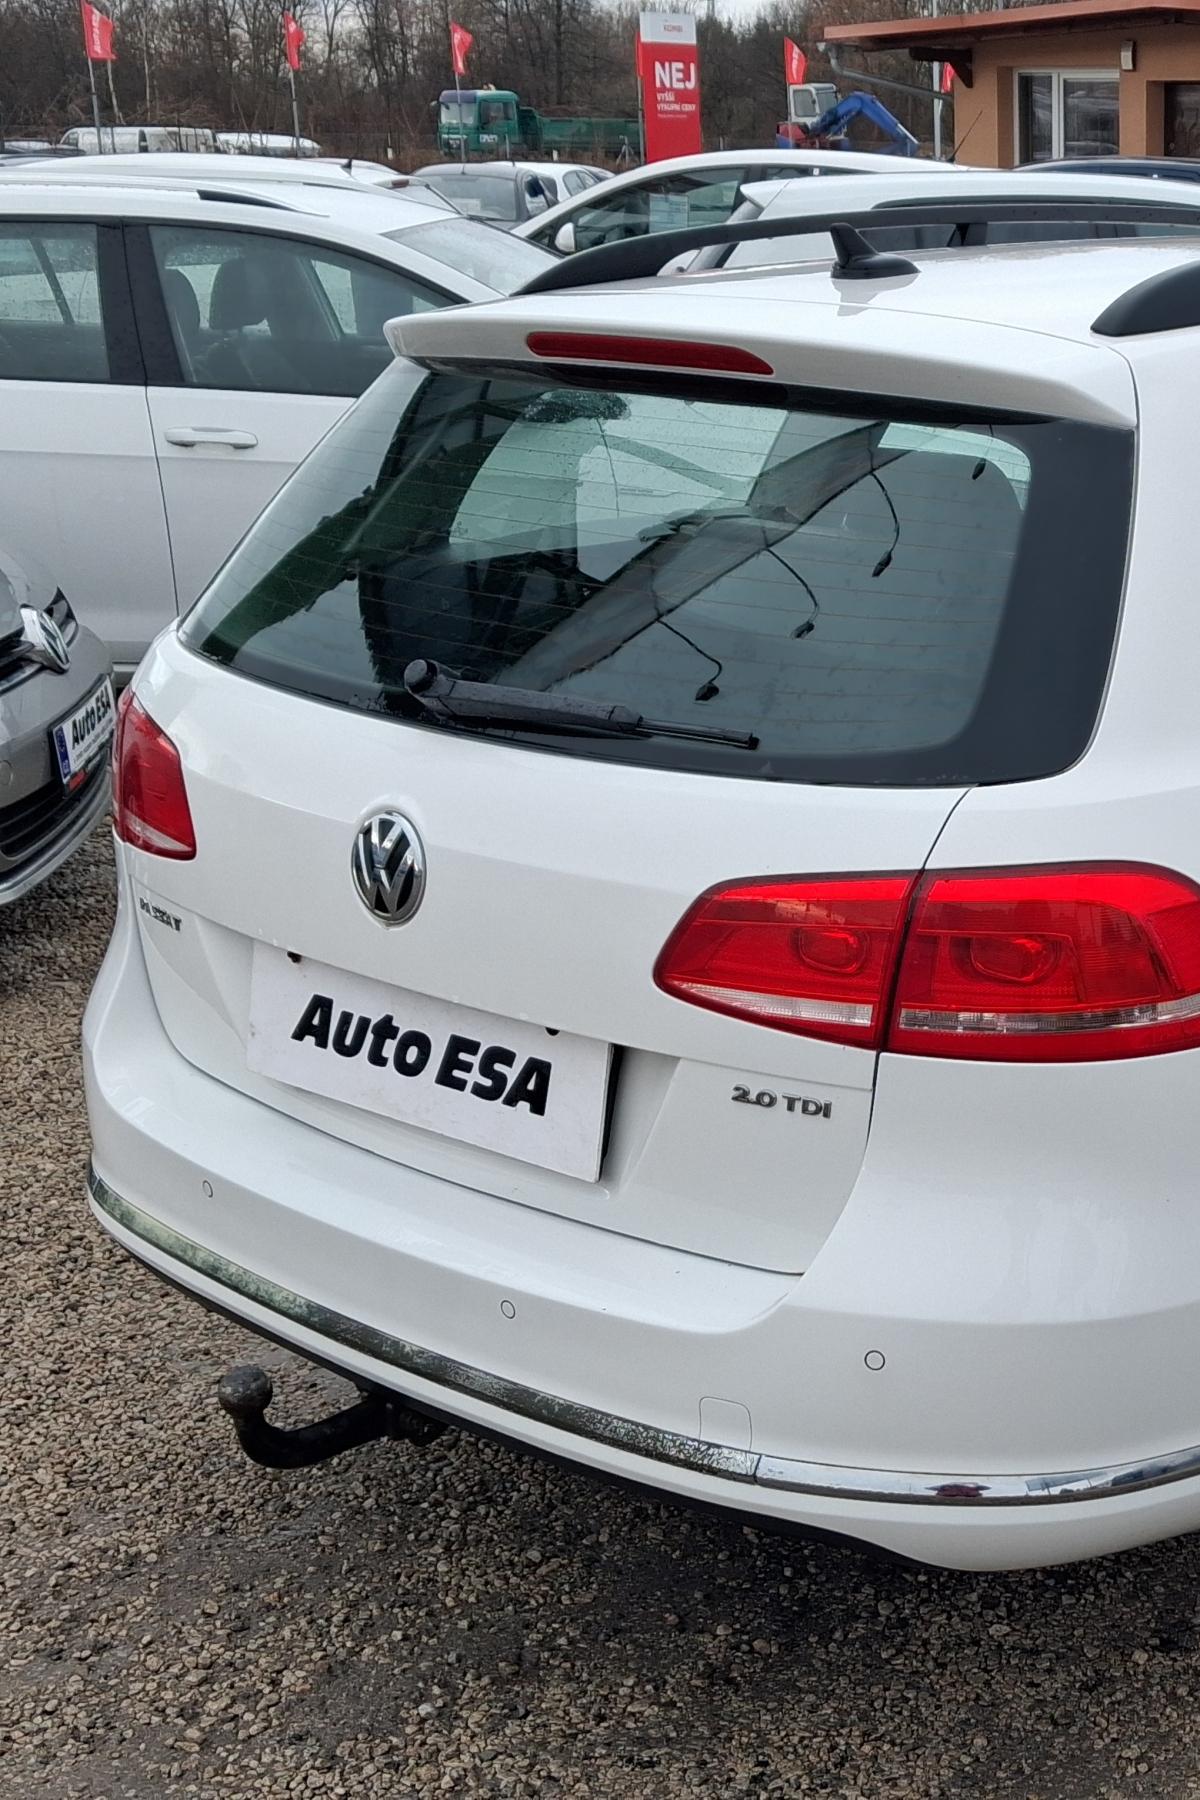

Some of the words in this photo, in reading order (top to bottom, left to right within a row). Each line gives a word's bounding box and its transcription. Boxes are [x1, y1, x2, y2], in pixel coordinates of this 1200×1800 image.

[655, 61, 696, 90] NEJ
[71, 705, 96, 750] Auto
[95, 684, 111, 724] ESA
[290, 993, 432, 1077] Auto
[434, 1033, 552, 1117] ESA
[731, 1083, 777, 1108] 2.0
[781, 1092, 832, 1119] TDI
